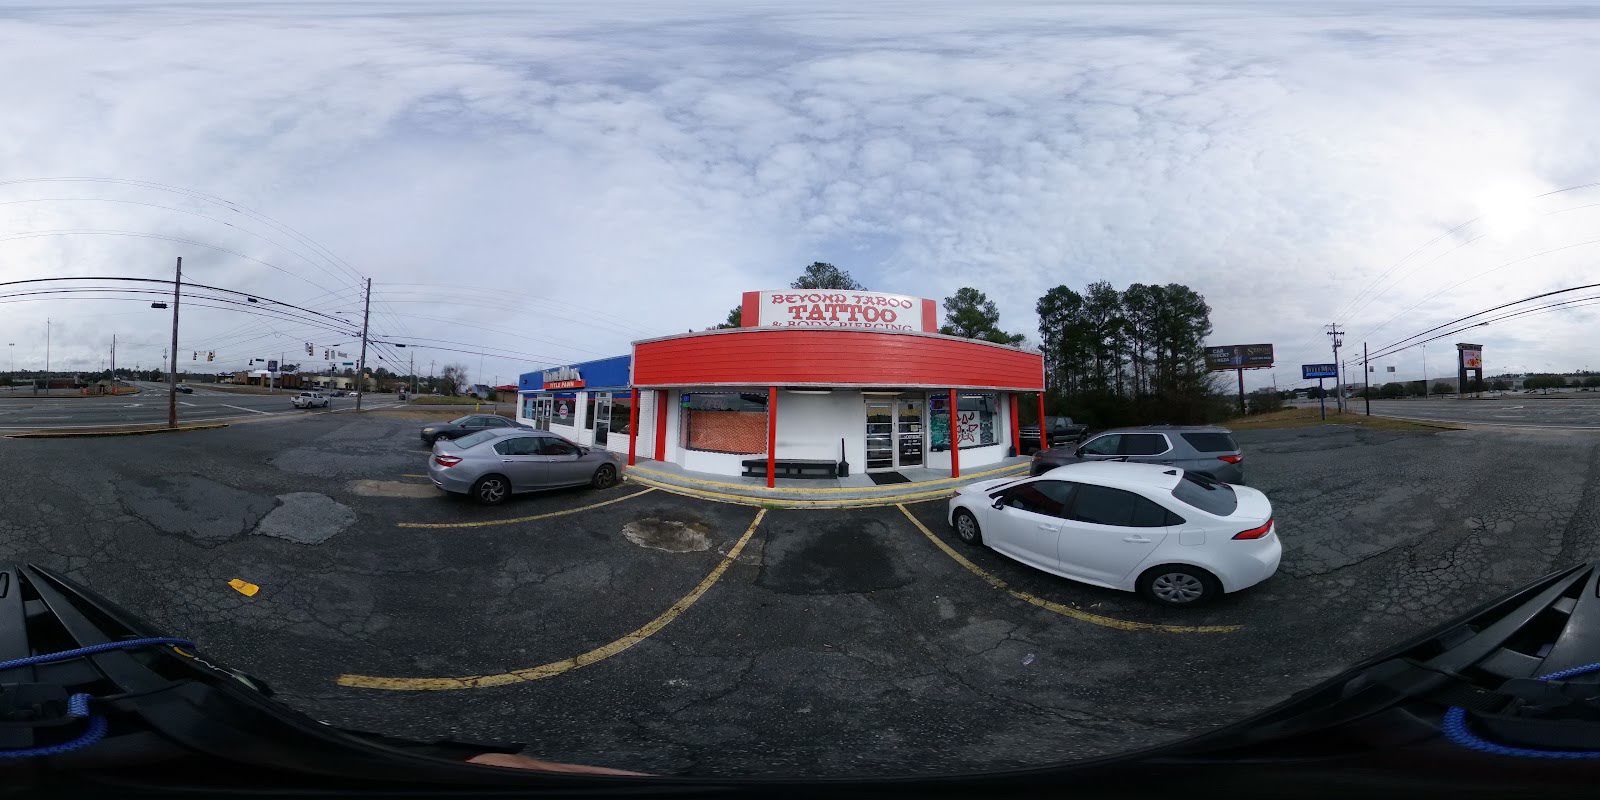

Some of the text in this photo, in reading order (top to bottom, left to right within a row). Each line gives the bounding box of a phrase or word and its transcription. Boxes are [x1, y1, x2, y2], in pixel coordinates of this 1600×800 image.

[772, 293, 913, 309] BEYOND TABOO
[788, 303, 897, 323] TATTOO
